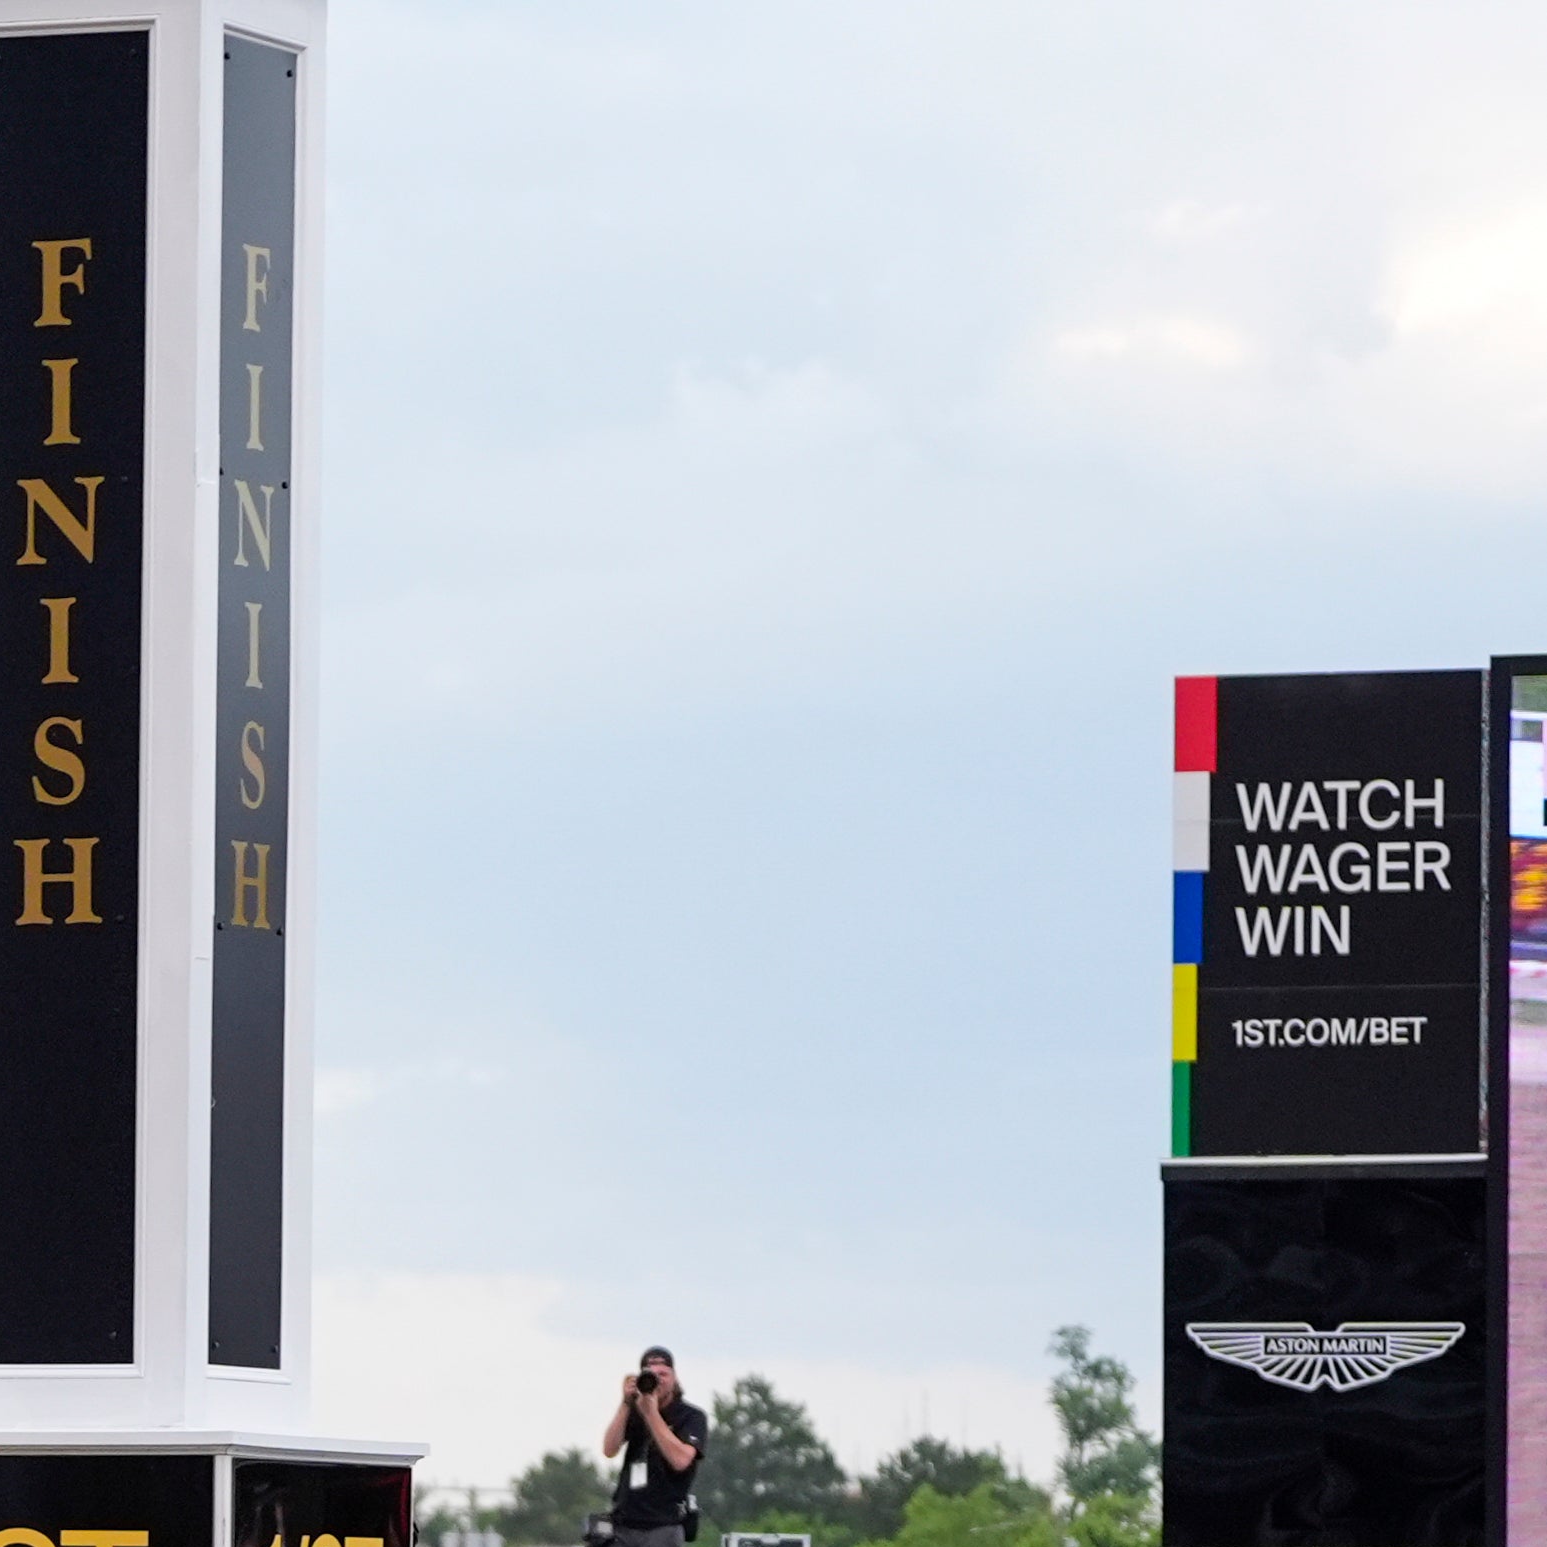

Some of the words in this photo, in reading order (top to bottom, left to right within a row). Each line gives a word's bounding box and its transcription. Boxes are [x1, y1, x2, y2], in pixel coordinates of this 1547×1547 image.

[13, 237, 103, 928] FINISH
[230, 242, 273, 931] FINISH
[1235, 778, 1445, 832] WATCH
[1235, 841, 1452, 895] WAGER
[1235, 905, 1352, 957] WIN
[1232, 1016, 1428, 1048] 1ST.COM/BET
[1266, 1337, 1320, 1353] ASTON
[1322, 1337, 1385, 1353] MARTIN
